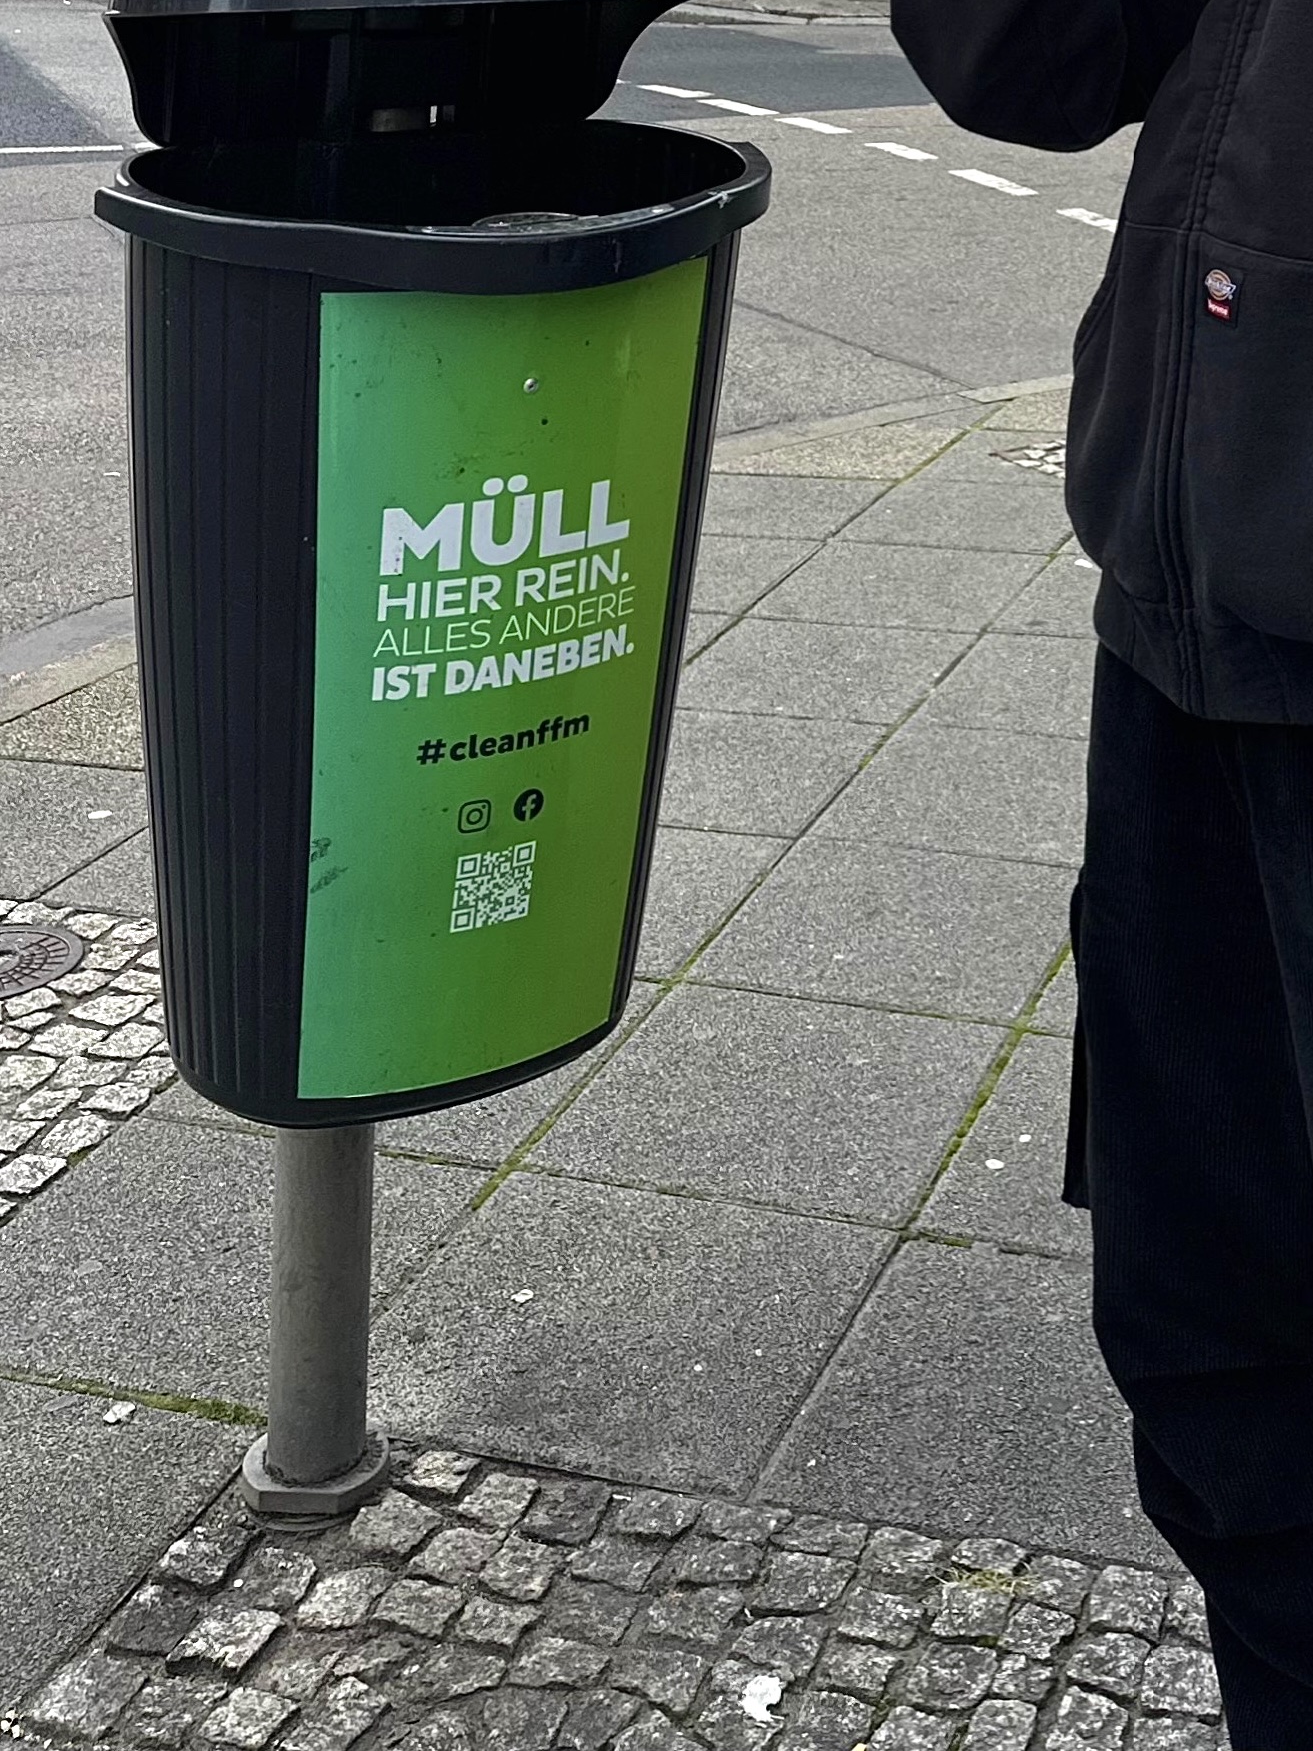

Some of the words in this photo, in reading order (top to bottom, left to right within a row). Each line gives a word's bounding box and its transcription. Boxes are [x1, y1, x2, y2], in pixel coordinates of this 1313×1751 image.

[379, 474, 630, 576] MÜLL
[373, 618, 493, 658] ALLES
[498, 585, 638, 646] ANDERE
[376, 572, 502, 623] HIER
[514, 548, 631, 608] REIN.
[371, 662, 437, 702] IST
[444, 624, 634, 696] DANEBEN.
[416, 714, 590, 765] #cleanffm
